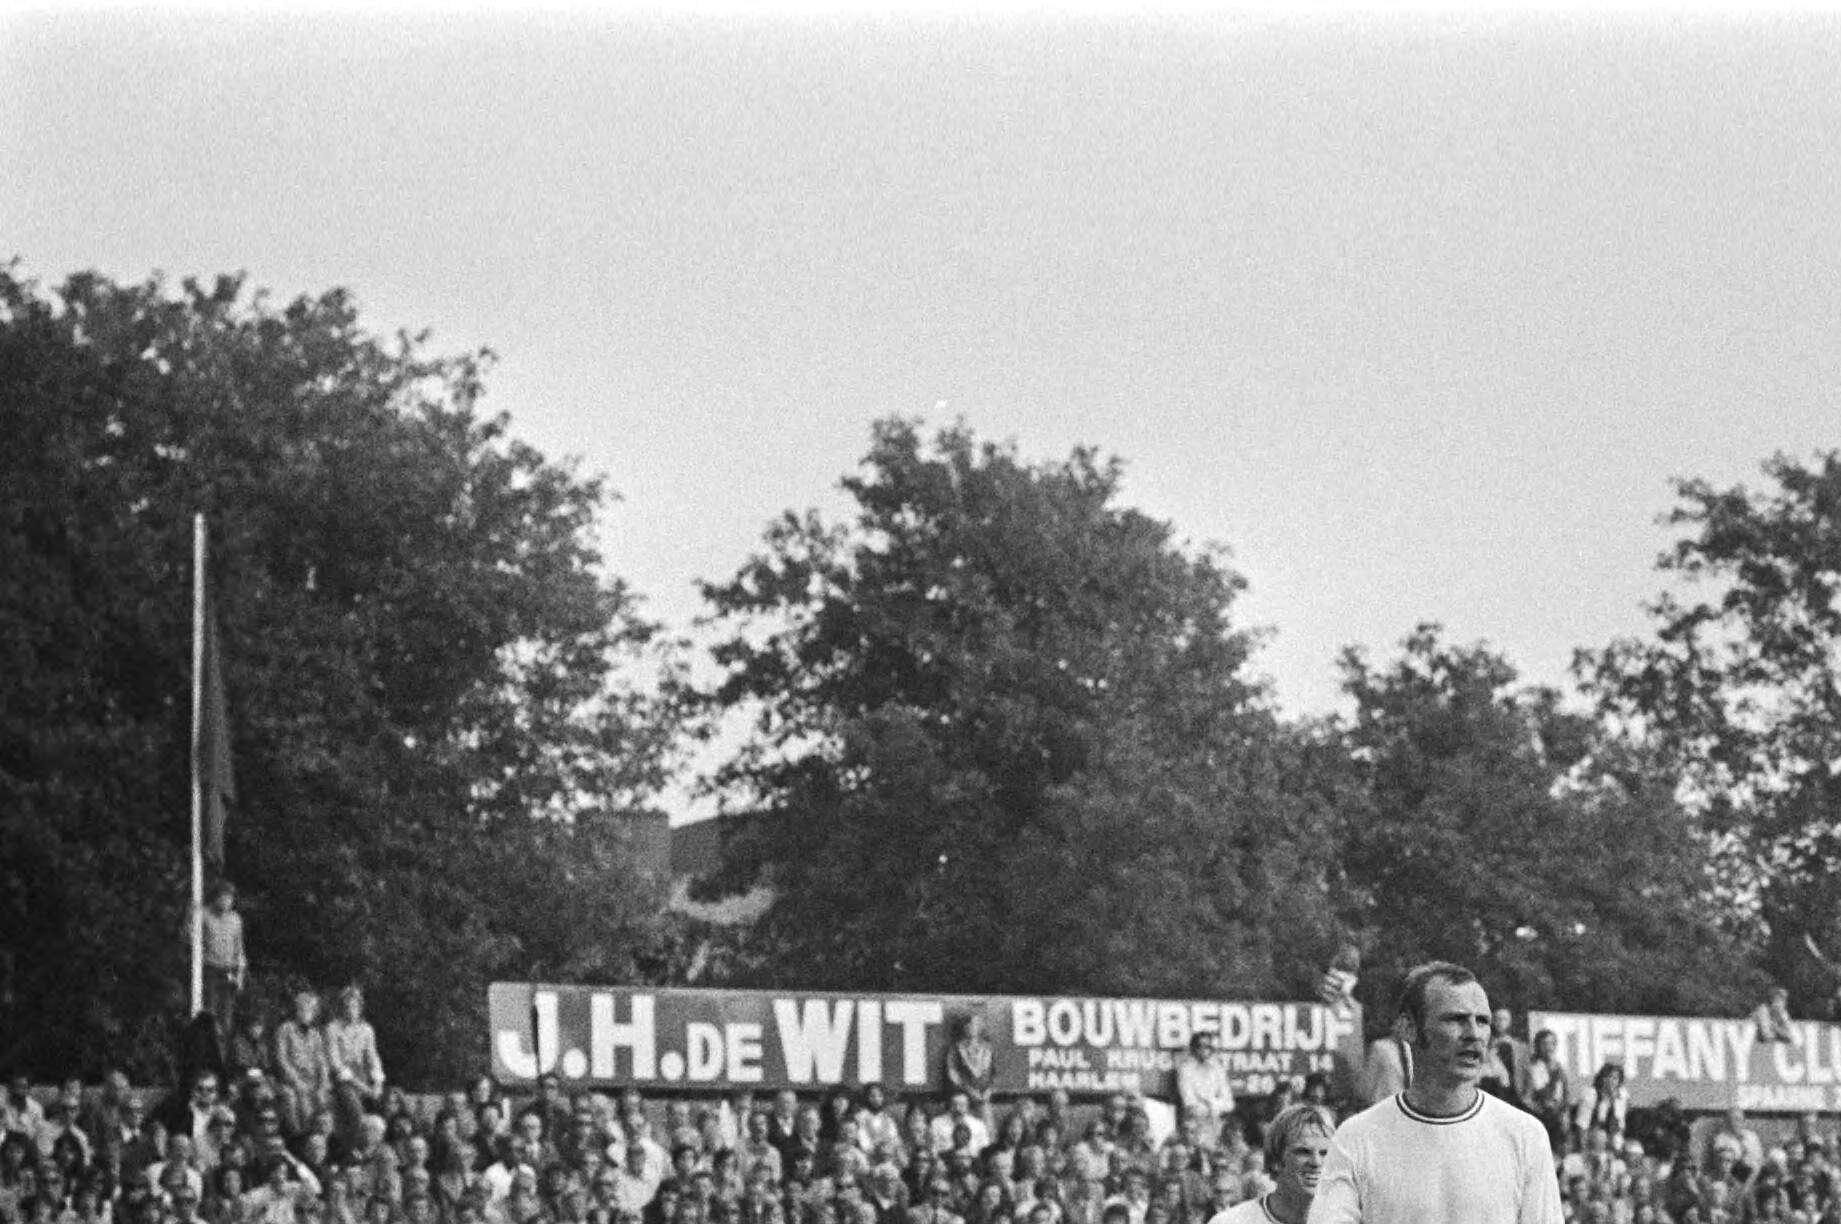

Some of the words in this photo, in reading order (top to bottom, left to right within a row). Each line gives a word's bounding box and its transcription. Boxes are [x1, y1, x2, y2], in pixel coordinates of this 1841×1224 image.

[499, 991, 686, 1081] J.H.
[687, 1022, 764, 1083] DE
[772, 998, 943, 1085] WIT
[1012, 1000, 1355, 1050] BOUWBEDRIJF
[1542, 1016, 1758, 1082] TIFFANY
[1028, 1048, 1092, 1068] PAUL
